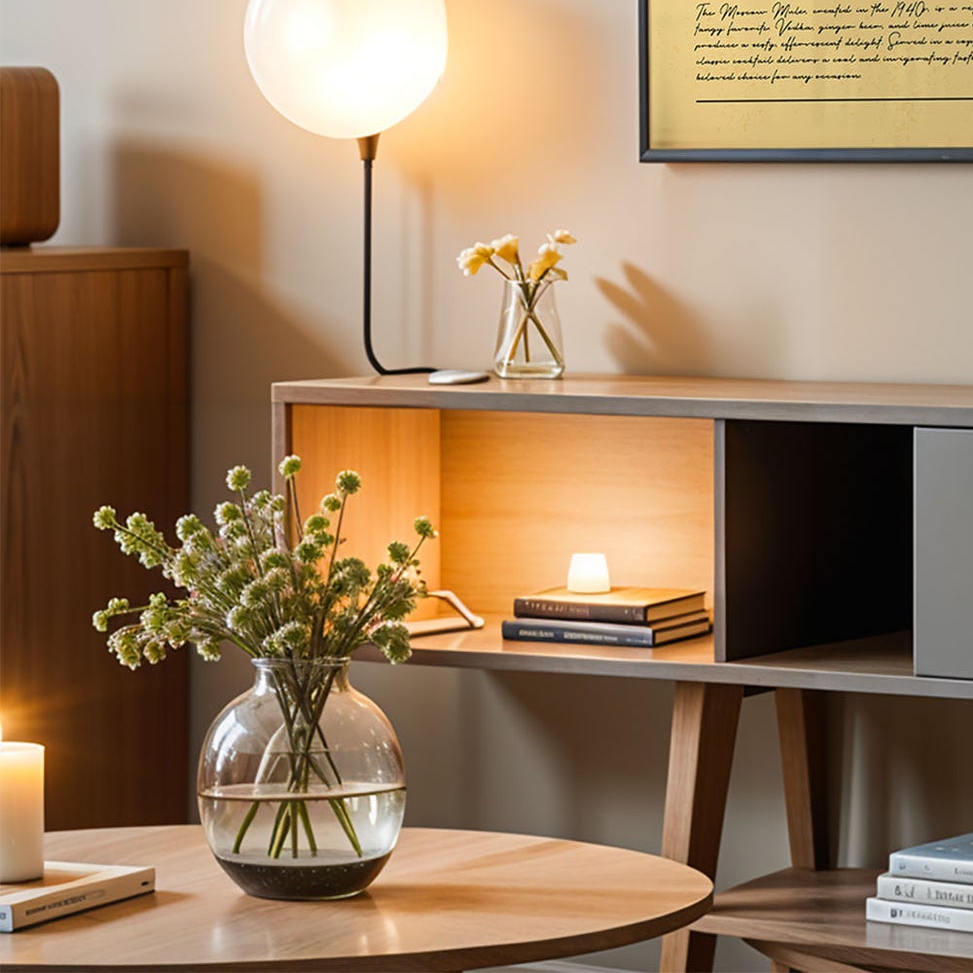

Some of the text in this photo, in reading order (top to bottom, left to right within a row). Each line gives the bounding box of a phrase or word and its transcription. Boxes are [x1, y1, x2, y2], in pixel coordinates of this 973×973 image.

[696, 3, 715, 21] The
[720, 3, 767, 21] Moscow
[813, 4, 852, 18] created
[870, 3, 889, 16] the
[694, 23, 725, 36] tangy
[818, 24, 856, 34] ginger
[938, 23, 969, 32] juice
[694, 40, 739, 51] produce
[781, 36, 843, 51] effervescent
[887, 31, 927, 50] Served
[696, 56, 730, 65] classic
[732, 54, 774, 67] cocktail
[776, 55, 819, 64] delivers
[833, 54, 856, 62] cool
[859, 54, 880, 62] and
[883, 51, 951, 65] invigorating
[696, 73, 735, 81] beloved
[737, 72, 770, 80] choice
[771, 69, 790, 84] for
[792, 75, 813, 84] any
